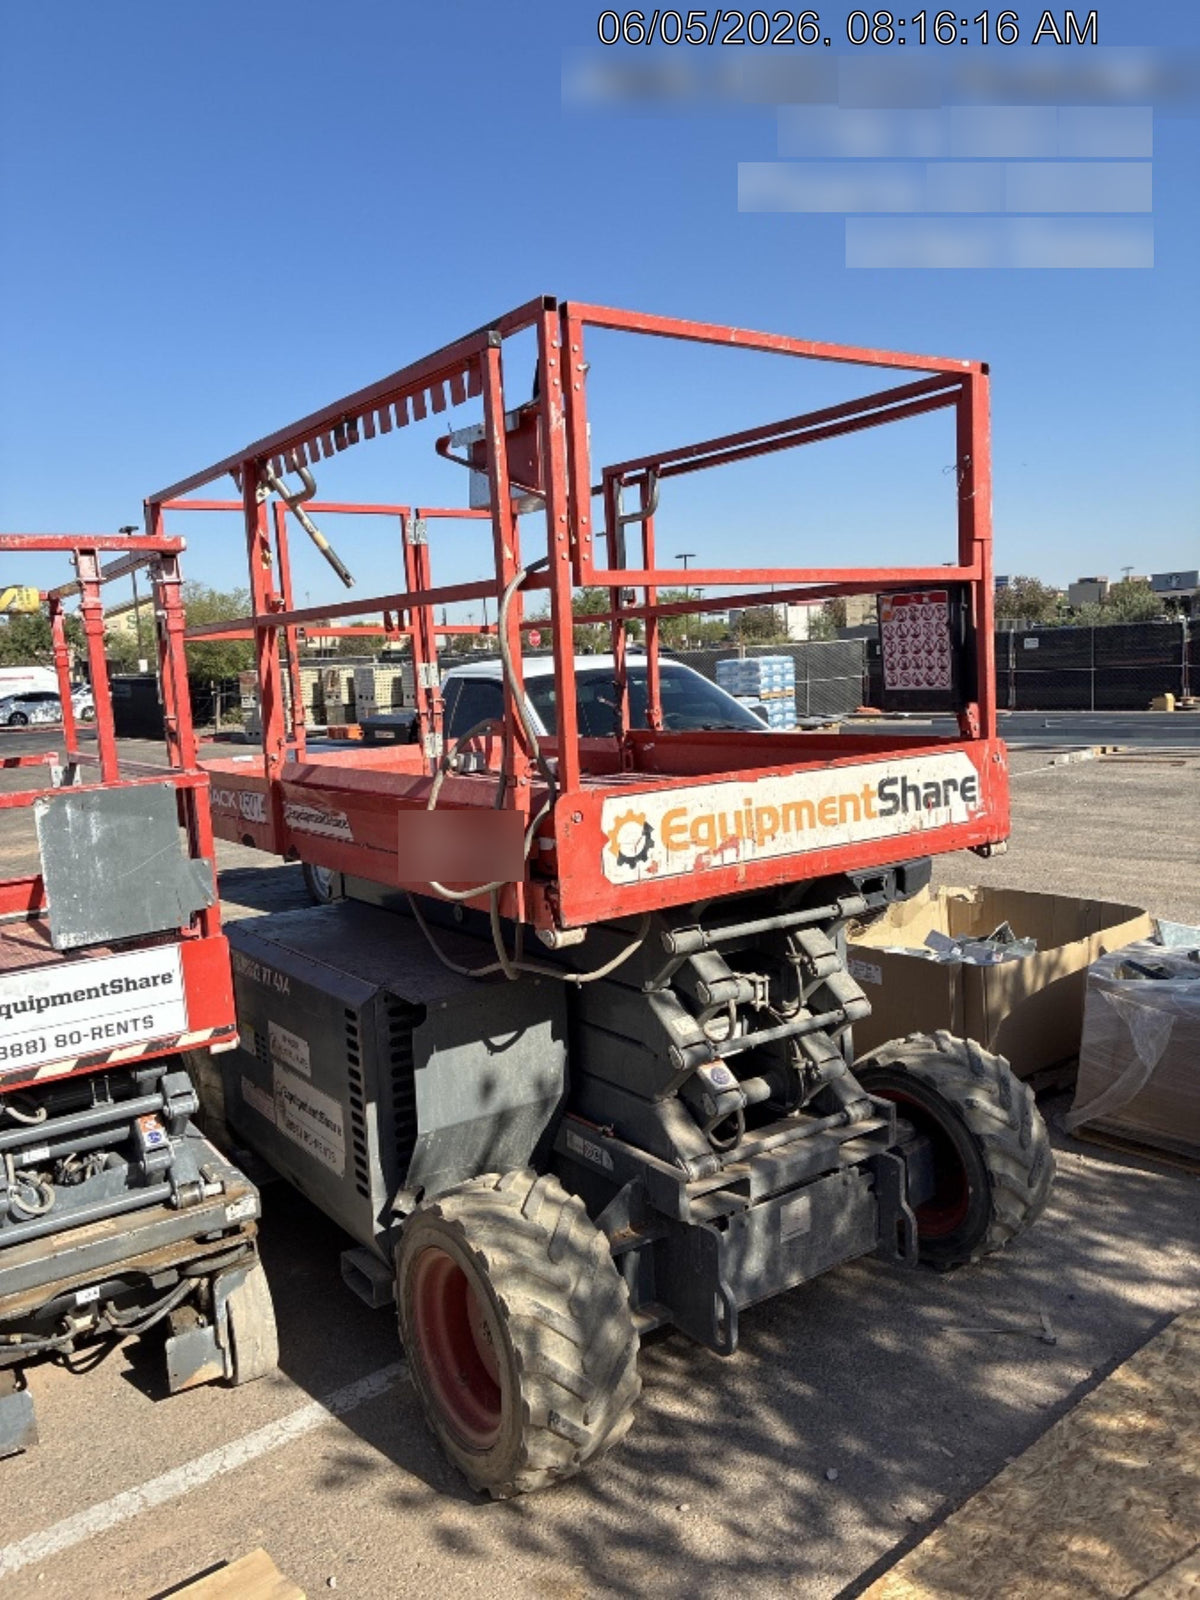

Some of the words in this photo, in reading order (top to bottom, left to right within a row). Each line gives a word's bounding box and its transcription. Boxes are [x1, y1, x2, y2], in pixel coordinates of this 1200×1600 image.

[661, 775, 978, 852] EquipmentShare
[0, 971, 173, 1020] quipmentShare
[0, 1037, 46, 1061] 888)
[54, 1014, 154, 1049] 80-RENTS
